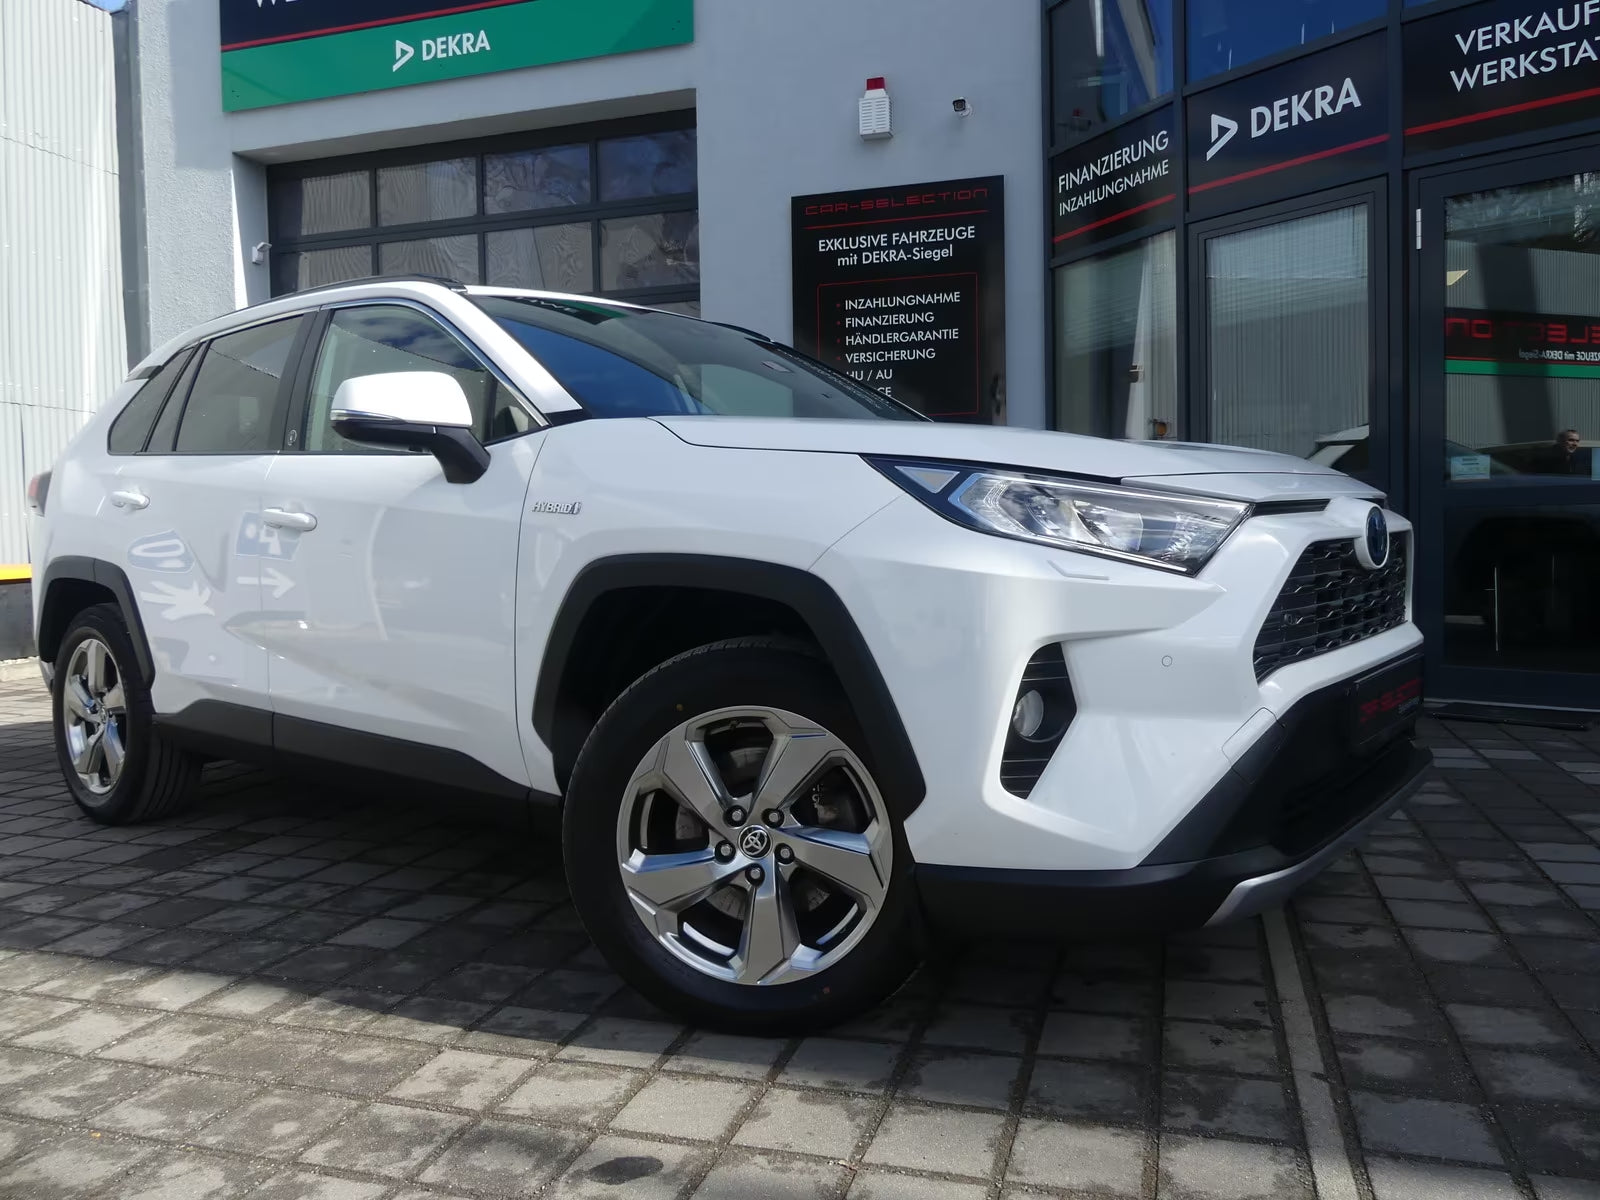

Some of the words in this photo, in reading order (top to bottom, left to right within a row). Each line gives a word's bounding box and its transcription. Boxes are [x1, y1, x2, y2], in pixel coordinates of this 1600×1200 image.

[1454, 0, 1600, 55] VERKAUF
[421, 30, 491, 61] DEKRA
[1449, 36, 1600, 92] WERKSTA
[1250, 77, 1362, 138] DEKRA
[1058, 130, 1169, 193] FINANZIERUNG
[1059, 159, 1169, 216] INZAHLUNGNAHME
[818, 234, 888, 251] EXKLUSIVE
[892, 226, 976, 245] FAHRZEUGE
[837, 253, 858, 266] mit
[862, 244, 953, 264] DEKRA-Siegel
[845, 291, 960, 310] INZAHLUNGNAHME
[845, 312, 935, 328] FINANZIERUNG
[845, 328, 959, 346] HÄNDLERGARANTIE
[845, 348, 936, 363] VERSICHERUNG
[875, 369, 893, 380] AU
